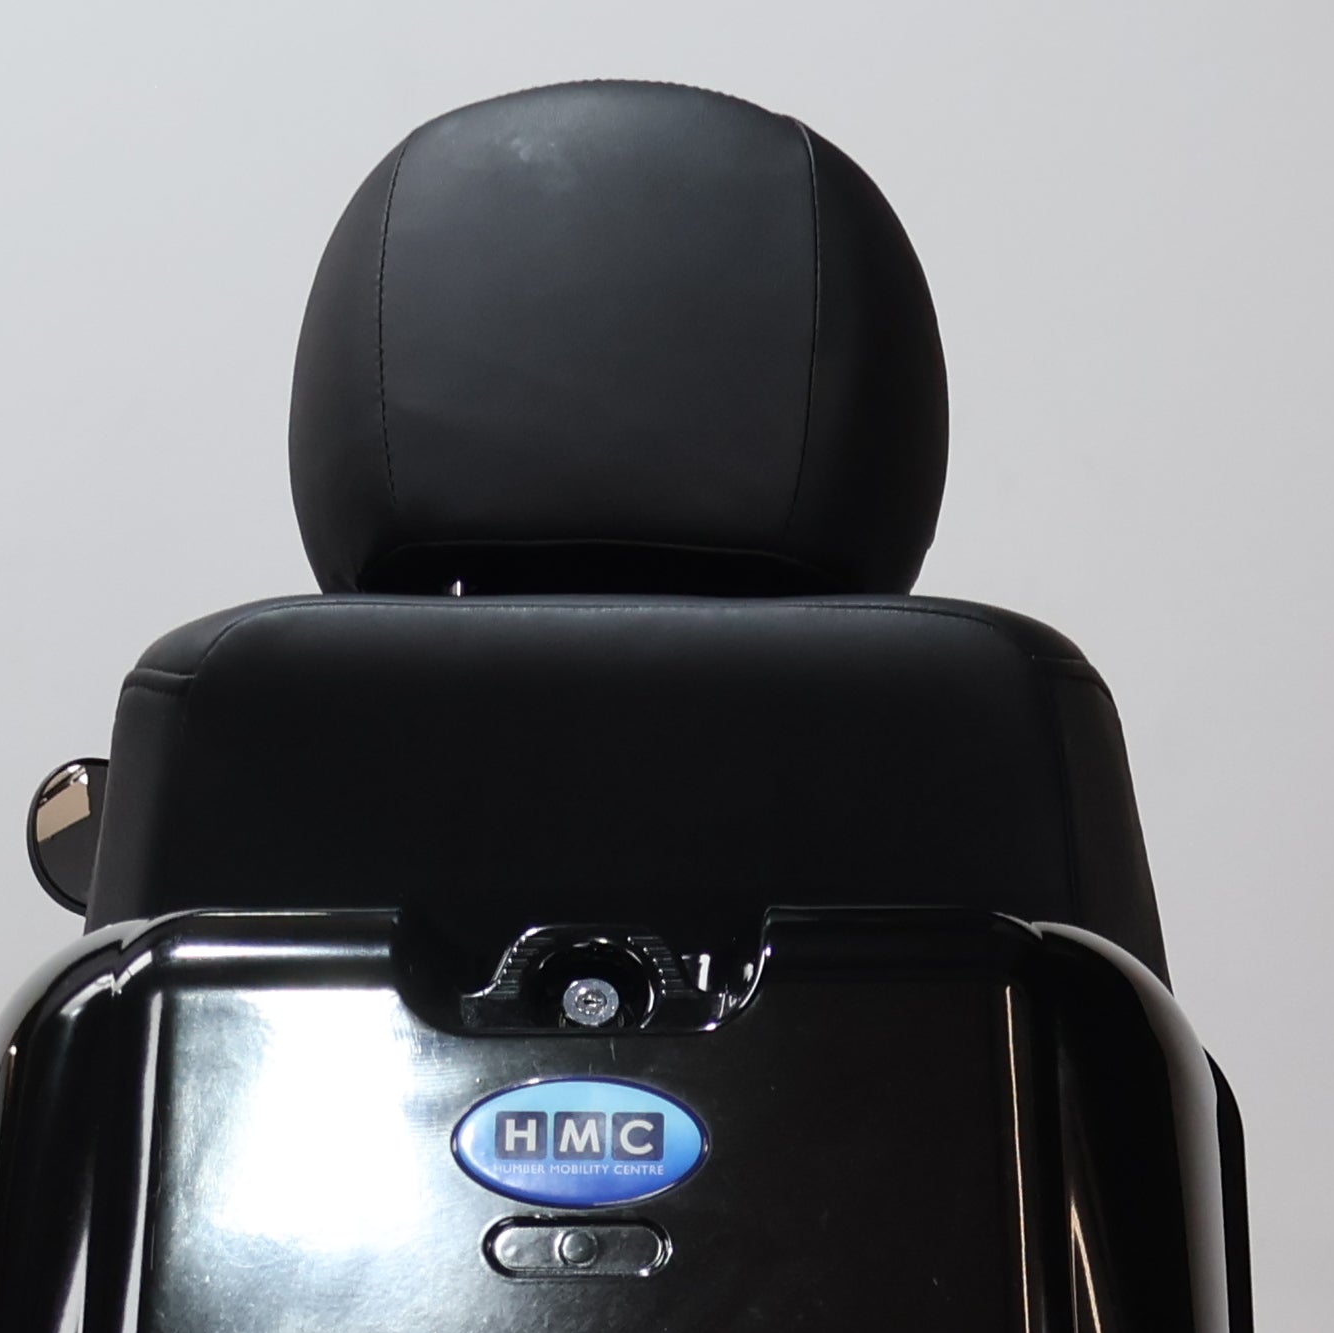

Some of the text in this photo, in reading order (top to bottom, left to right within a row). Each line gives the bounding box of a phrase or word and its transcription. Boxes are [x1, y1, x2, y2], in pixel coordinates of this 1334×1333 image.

[505, 1119, 655, 1155] HMC
[492, 1163, 664, 1176] HUMBER MOBILITY CENTRE
